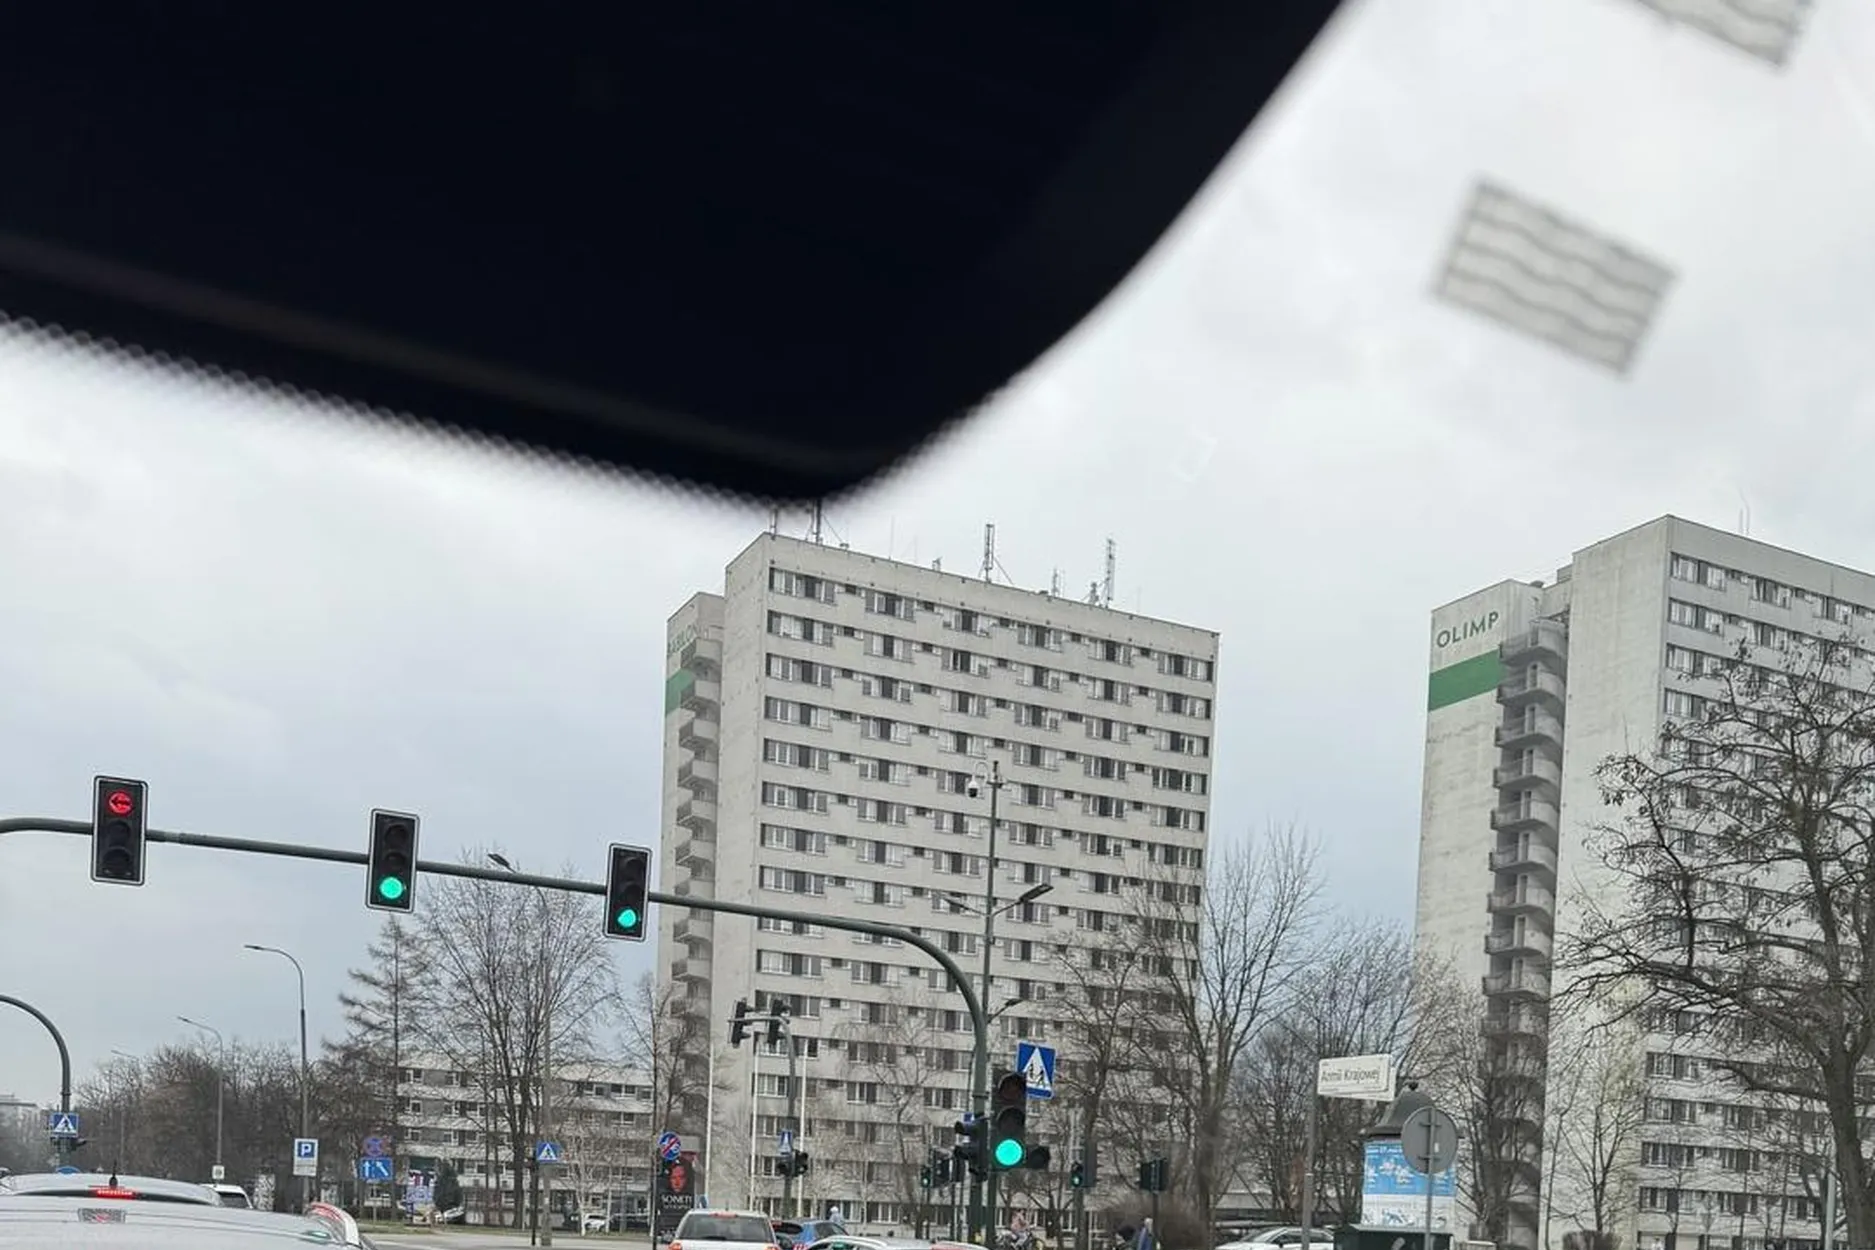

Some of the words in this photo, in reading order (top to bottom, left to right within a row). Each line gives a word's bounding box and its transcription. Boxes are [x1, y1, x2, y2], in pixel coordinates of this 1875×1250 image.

[1436, 611, 1499, 648] OLIMP
[1344, 1066, 1380, 1084] Krajowej
[301, 1143, 312, 1156] P
